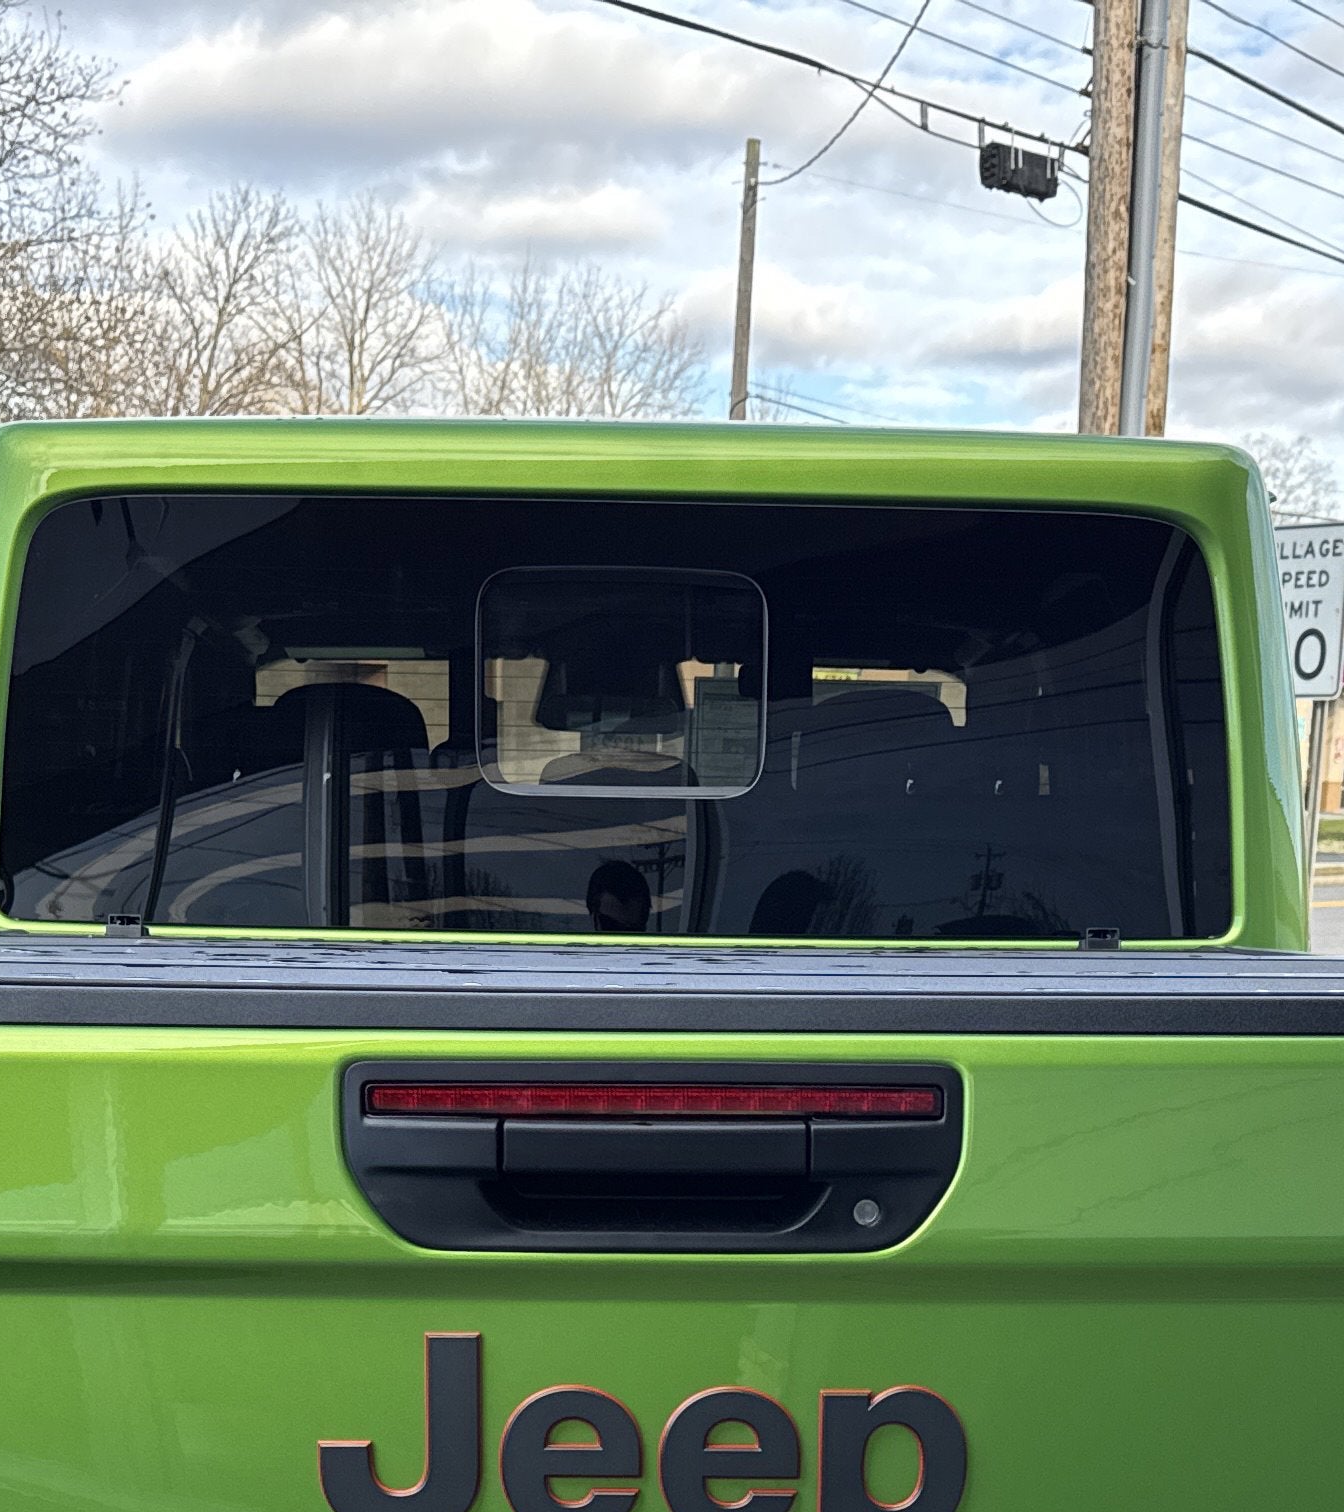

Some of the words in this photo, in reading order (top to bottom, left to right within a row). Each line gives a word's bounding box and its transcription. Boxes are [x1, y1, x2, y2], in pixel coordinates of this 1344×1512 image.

[1277, 539, 1344, 560] LLAGE
[1281, 569, 1330, 589] PEED
[1284, 600, 1323, 619] MIT
[1294, 627, 1327, 681] 0
